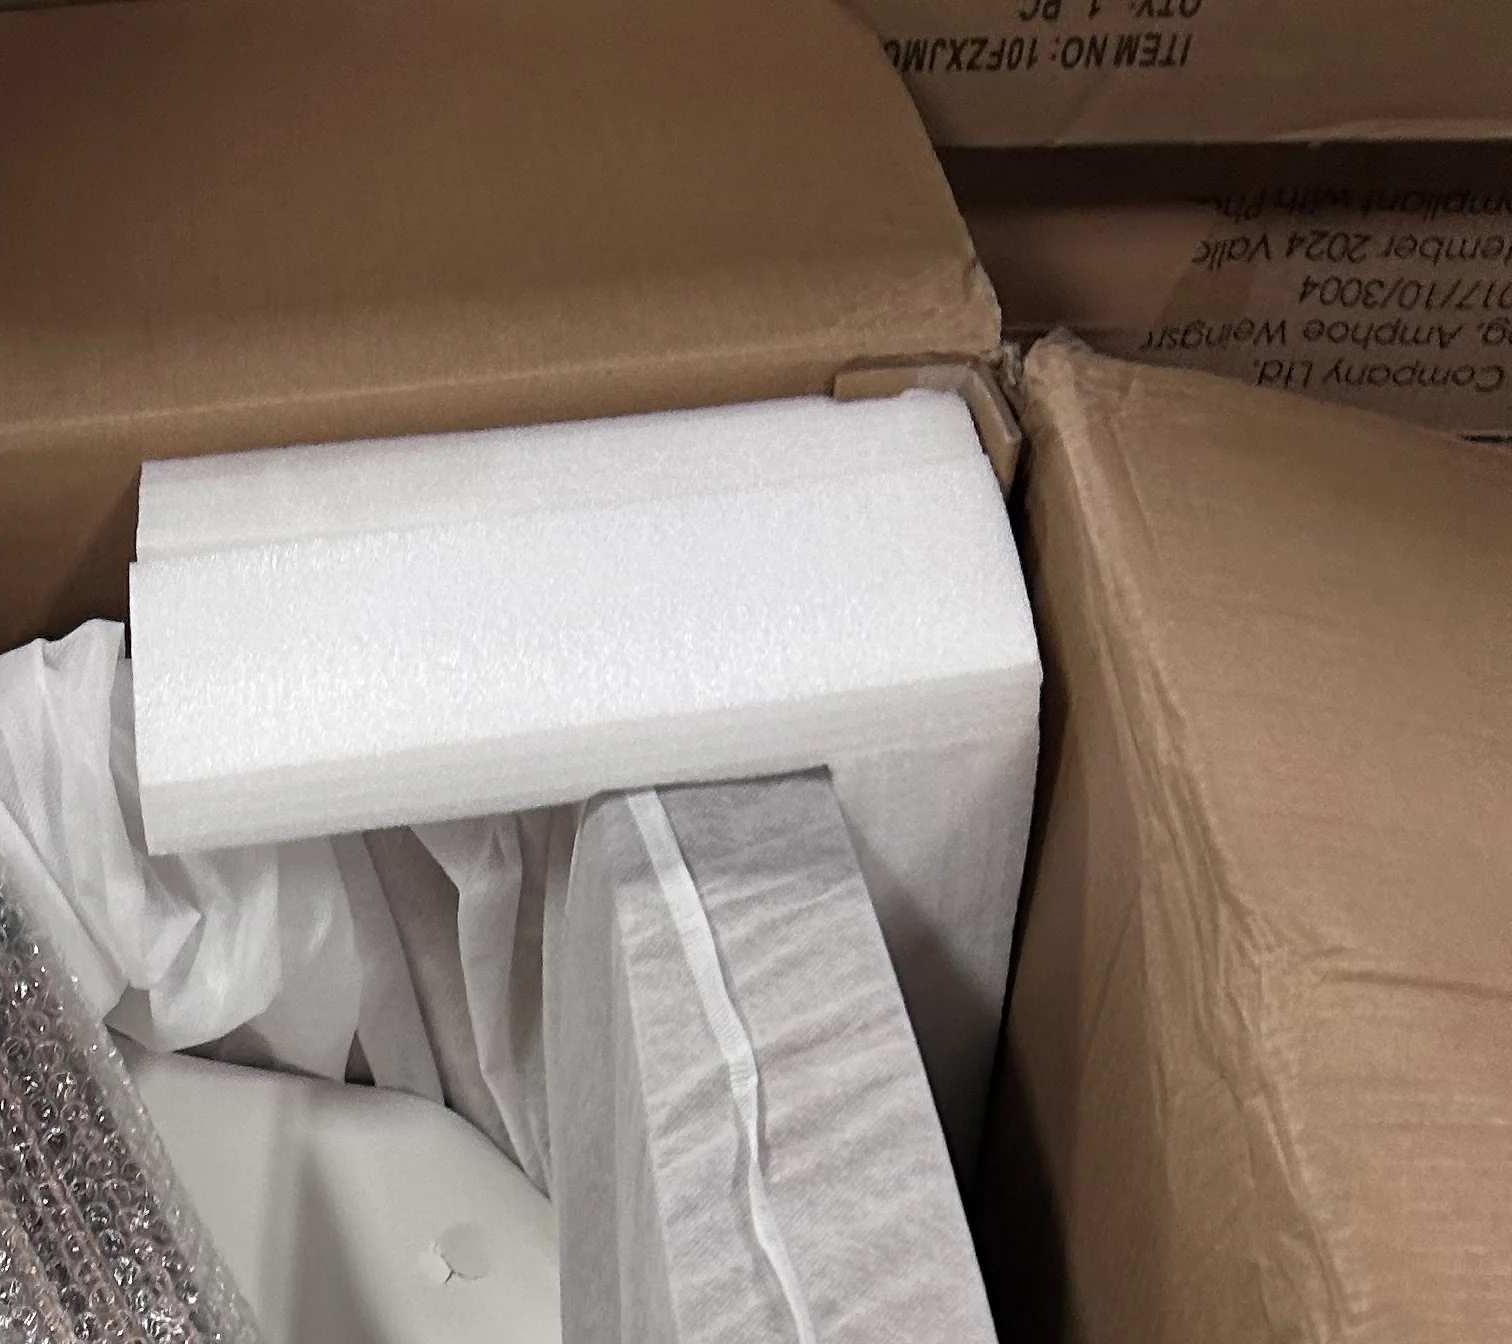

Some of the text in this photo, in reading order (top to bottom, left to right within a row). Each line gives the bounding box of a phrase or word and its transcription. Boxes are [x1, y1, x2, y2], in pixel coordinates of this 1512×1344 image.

[1050, 32, 1108, 71] NO:
[1112, 31, 1193, 67] ITEM
[1285, 231, 1368, 262] 2024
[1302, 317, 1462, 350] Amphoe
[1251, 357, 1504, 393] Company Ltd.
